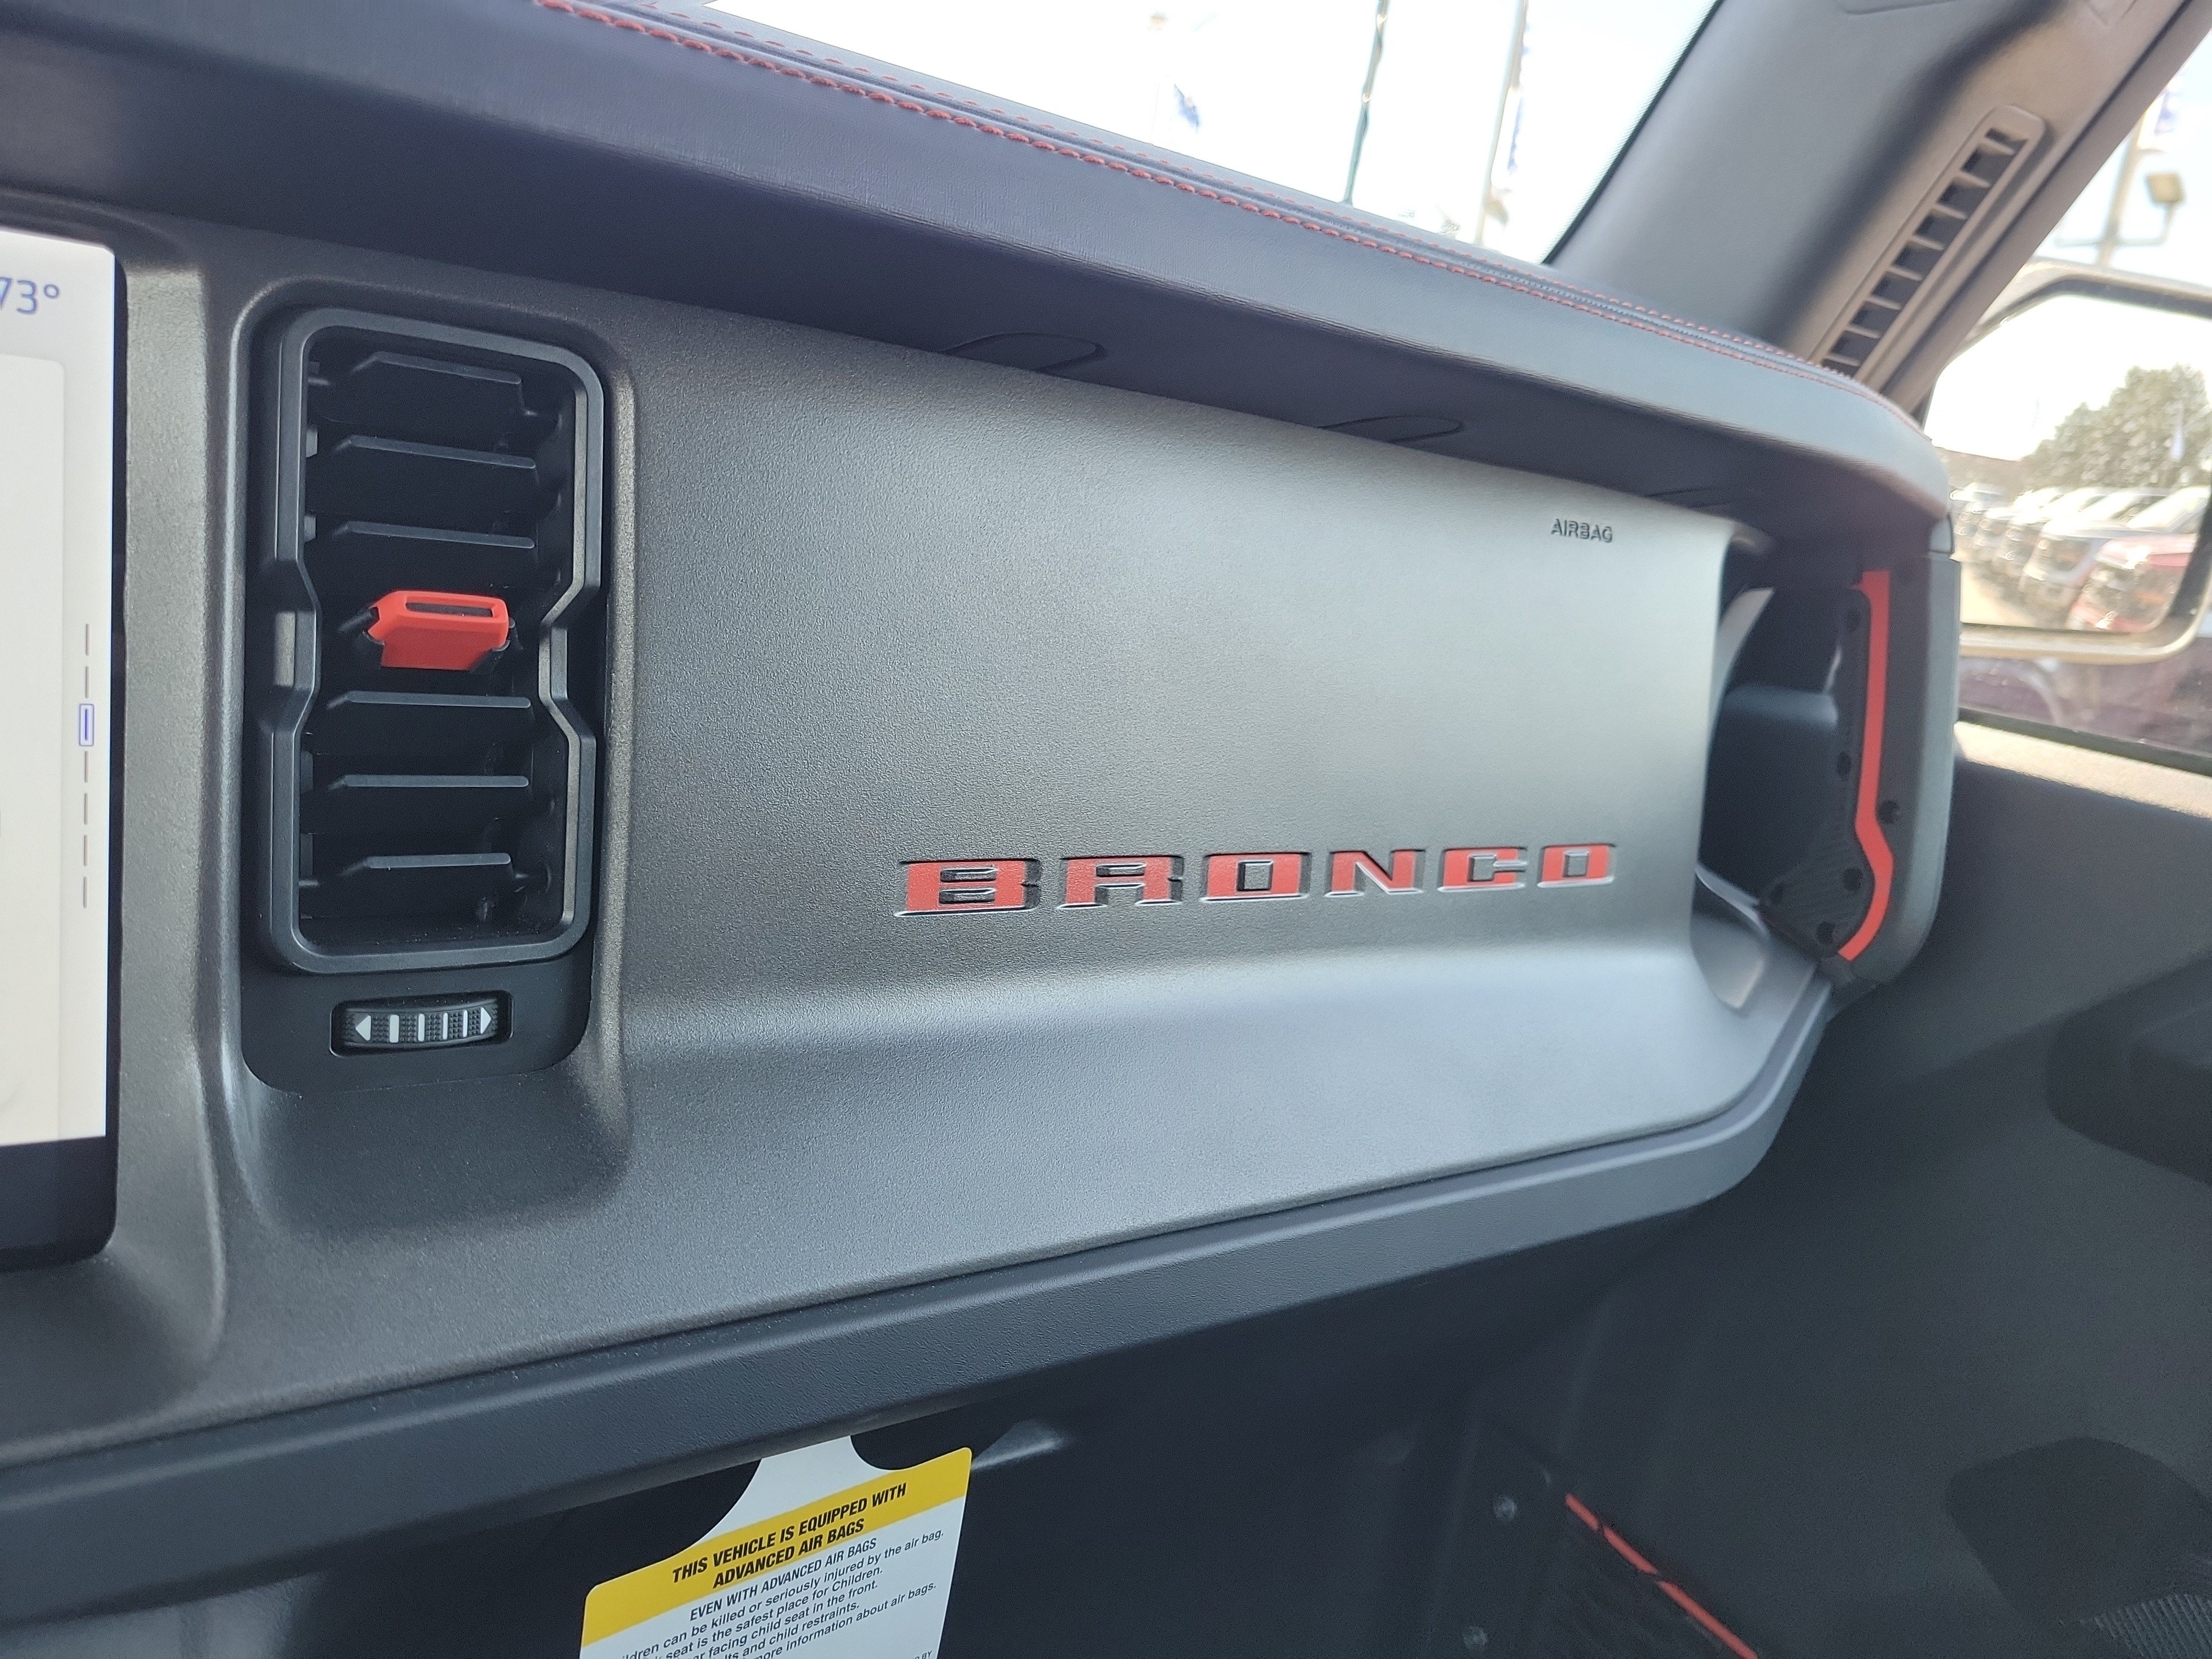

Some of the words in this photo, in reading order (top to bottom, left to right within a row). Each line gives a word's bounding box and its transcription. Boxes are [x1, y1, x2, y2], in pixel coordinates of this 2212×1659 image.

[1550, 518, 1612, 543] AIRBAG
[894, 843, 1616, 917] BRONCO
[673, 1557, 708, 1583] THIS
[713, 1532, 776, 1567] VEHICLE
[780, 1526, 795, 1543] IS
[799, 1497, 867, 1534] EQUIPPED
[872, 1482, 907, 1507] WITH
[713, 1545, 795, 1589] ADVANCED
[798, 1534, 823, 1556] AIR
[827, 1518, 865, 1544] BAGS
[663, 1632, 687, 1648] can
[691, 1624, 707, 1637] be
[711, 1606, 746, 1629] killed
[749, 1601, 763, 1613] or
[765, 1577, 821, 1606] seriously
[823, 1558, 865, 1582] injured
[867, 1553, 882, 1566] by
[884, 1545, 902, 1559] the
[904, 1538, 919, 1551] air
[921, 1530, 944, 1544] bag.
[665, 1641, 693, 1659] seat
[697, 1638, 708, 1649] is
[712, 1628, 732, 1642] the
[735, 1609, 774, 1632] safest
[776, 1595, 809, 1618] place
[812, 1587, 829, 1601] for
[832, 1567, 883, 1592] Children.
[690, 1598, 723, 1622] EVEN
[726, 1584, 758, 1607] WITH
[760, 1559, 822, 1593] ADVANCED
[825, 1550, 844, 1567] AIR
[847, 1538, 877, 1558] BAGS
[709, 1634, 748, 1657] facing
[751, 1618, 781, 1639] child
[784, 1607, 810, 1625] seat
[812, 1602, 823, 1614] in
[827, 1594, 845, 1607] the
[848, 1579, 878, 1599] front.
[786, 1616, 853, 1651] information
[856, 1600, 889, 1622] about
[890, 1594, 906, 1607] air
[907, 1582, 936, 1600] bags.
[742, 1638, 766, 1657] and
[769, 1624, 799, 1645] child
[802, 1601, 860, 1632] restraints.
